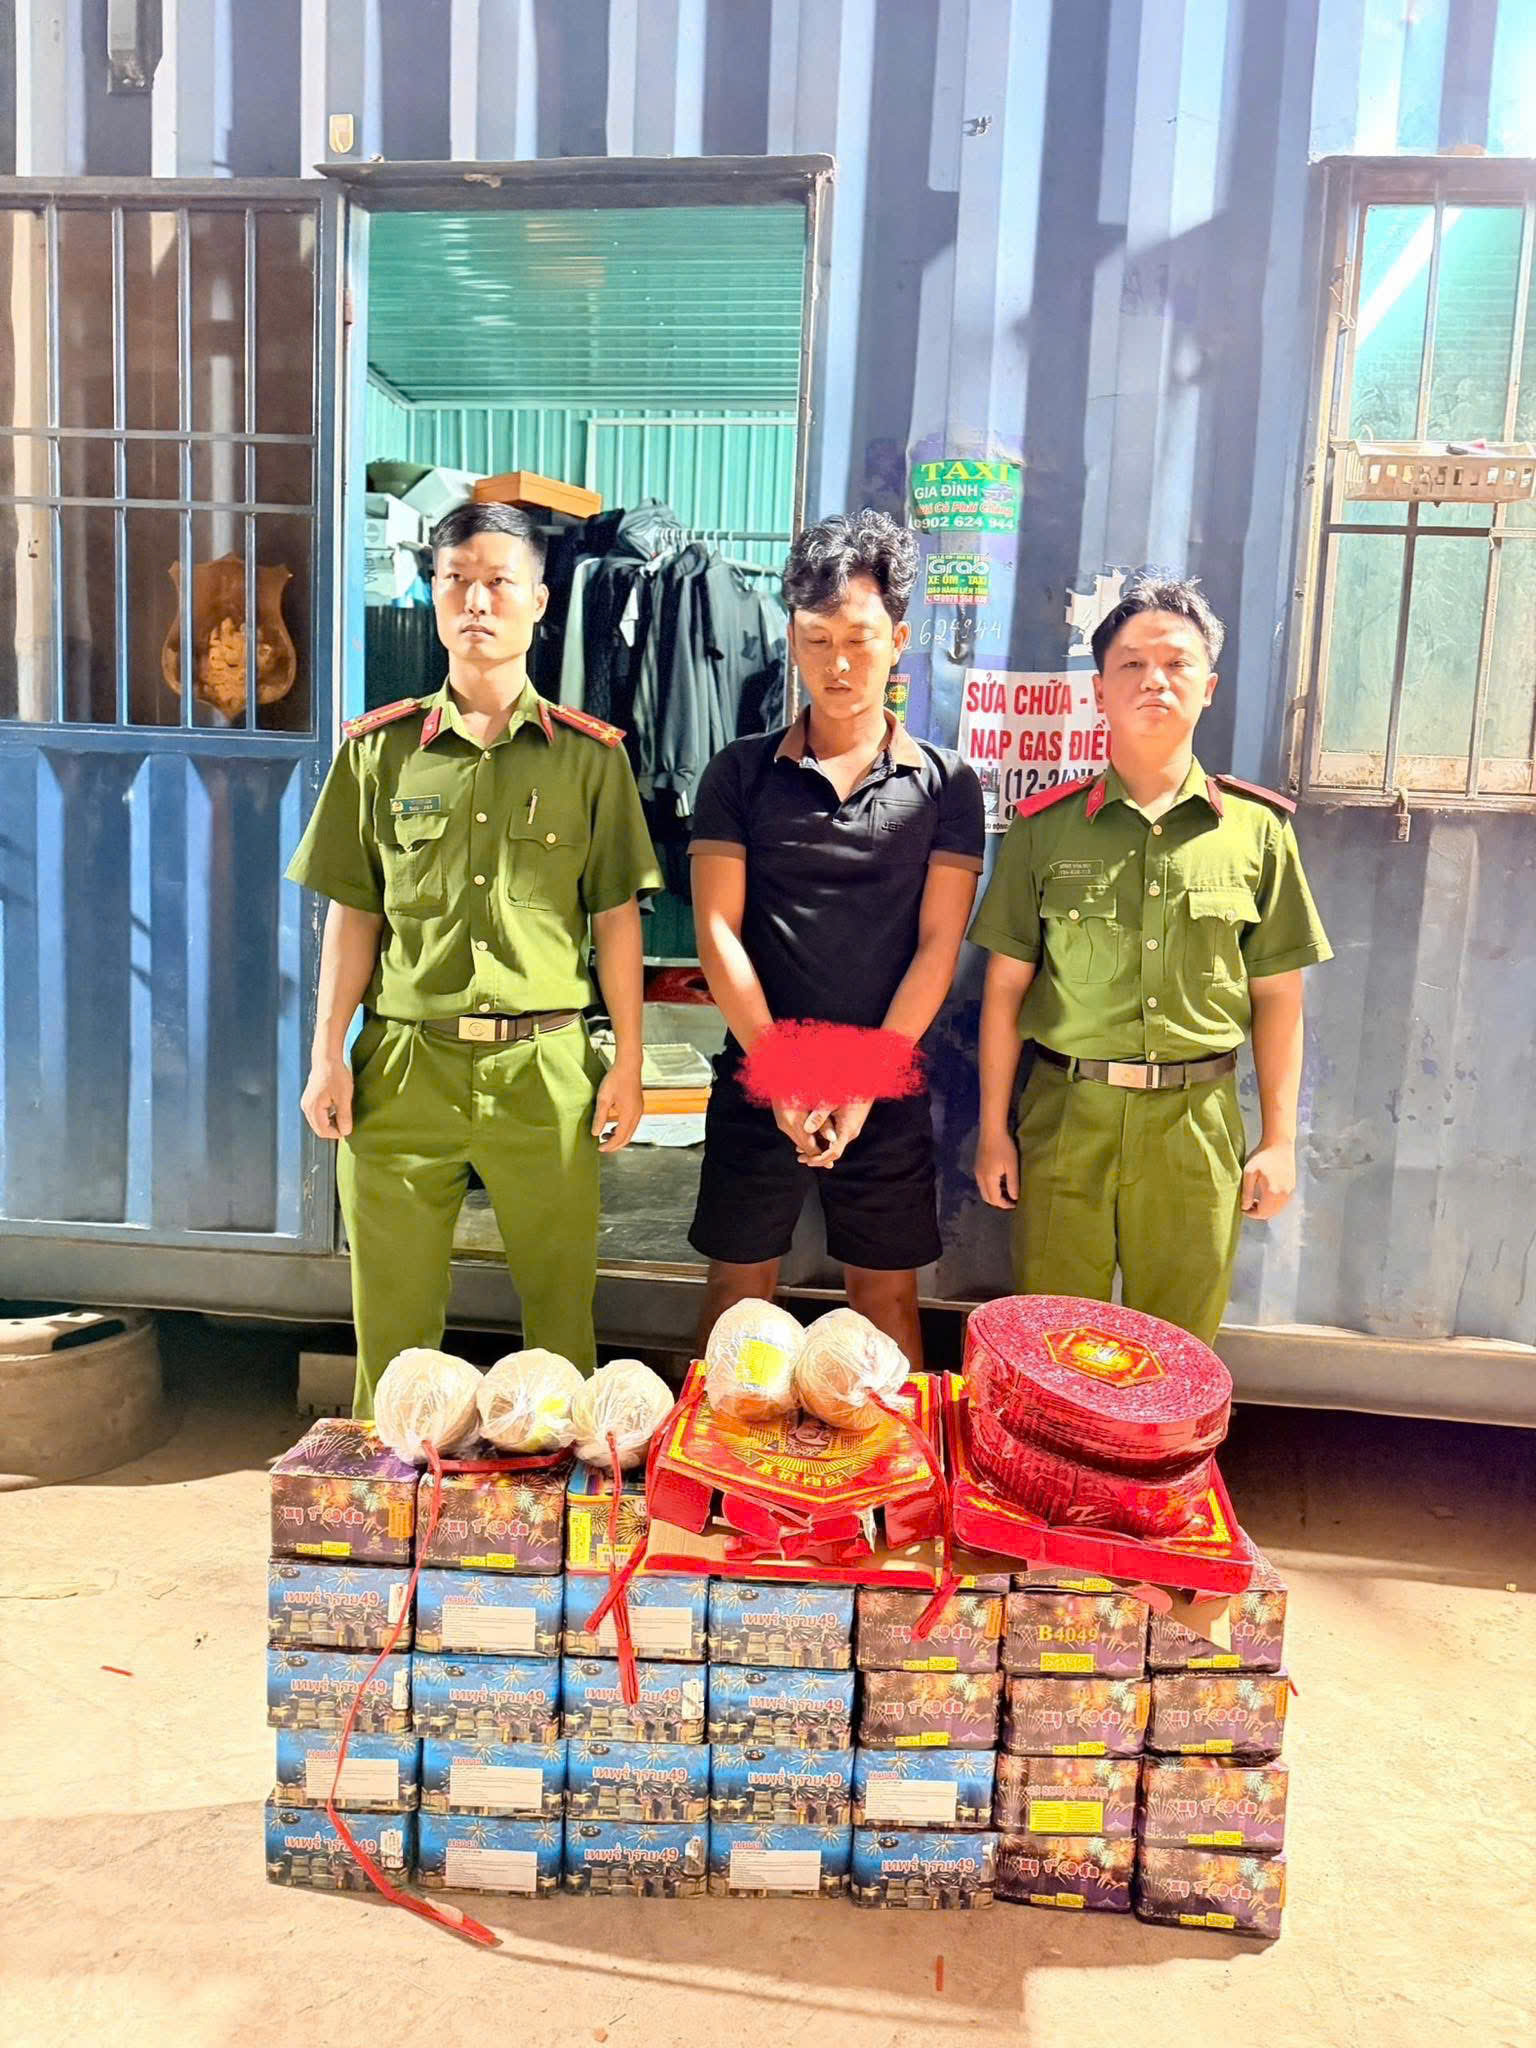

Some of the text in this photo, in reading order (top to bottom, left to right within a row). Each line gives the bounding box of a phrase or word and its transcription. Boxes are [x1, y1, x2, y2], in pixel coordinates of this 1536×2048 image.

[920, 461, 1010, 483] TAXI
[914, 481, 979, 500] GIA ĐÌNH
[954, 516, 984, 528] 624
[989, 518, 1014, 529] 944
[966, 672, 1008, 715] SỬA
[1014, 679, 1073, 716] CHỮA
[970, 728, 1013, 766] NẠP
[1019, 731, 1063, 762] GAS
[1039, 1624, 1099, 1642] B4049
